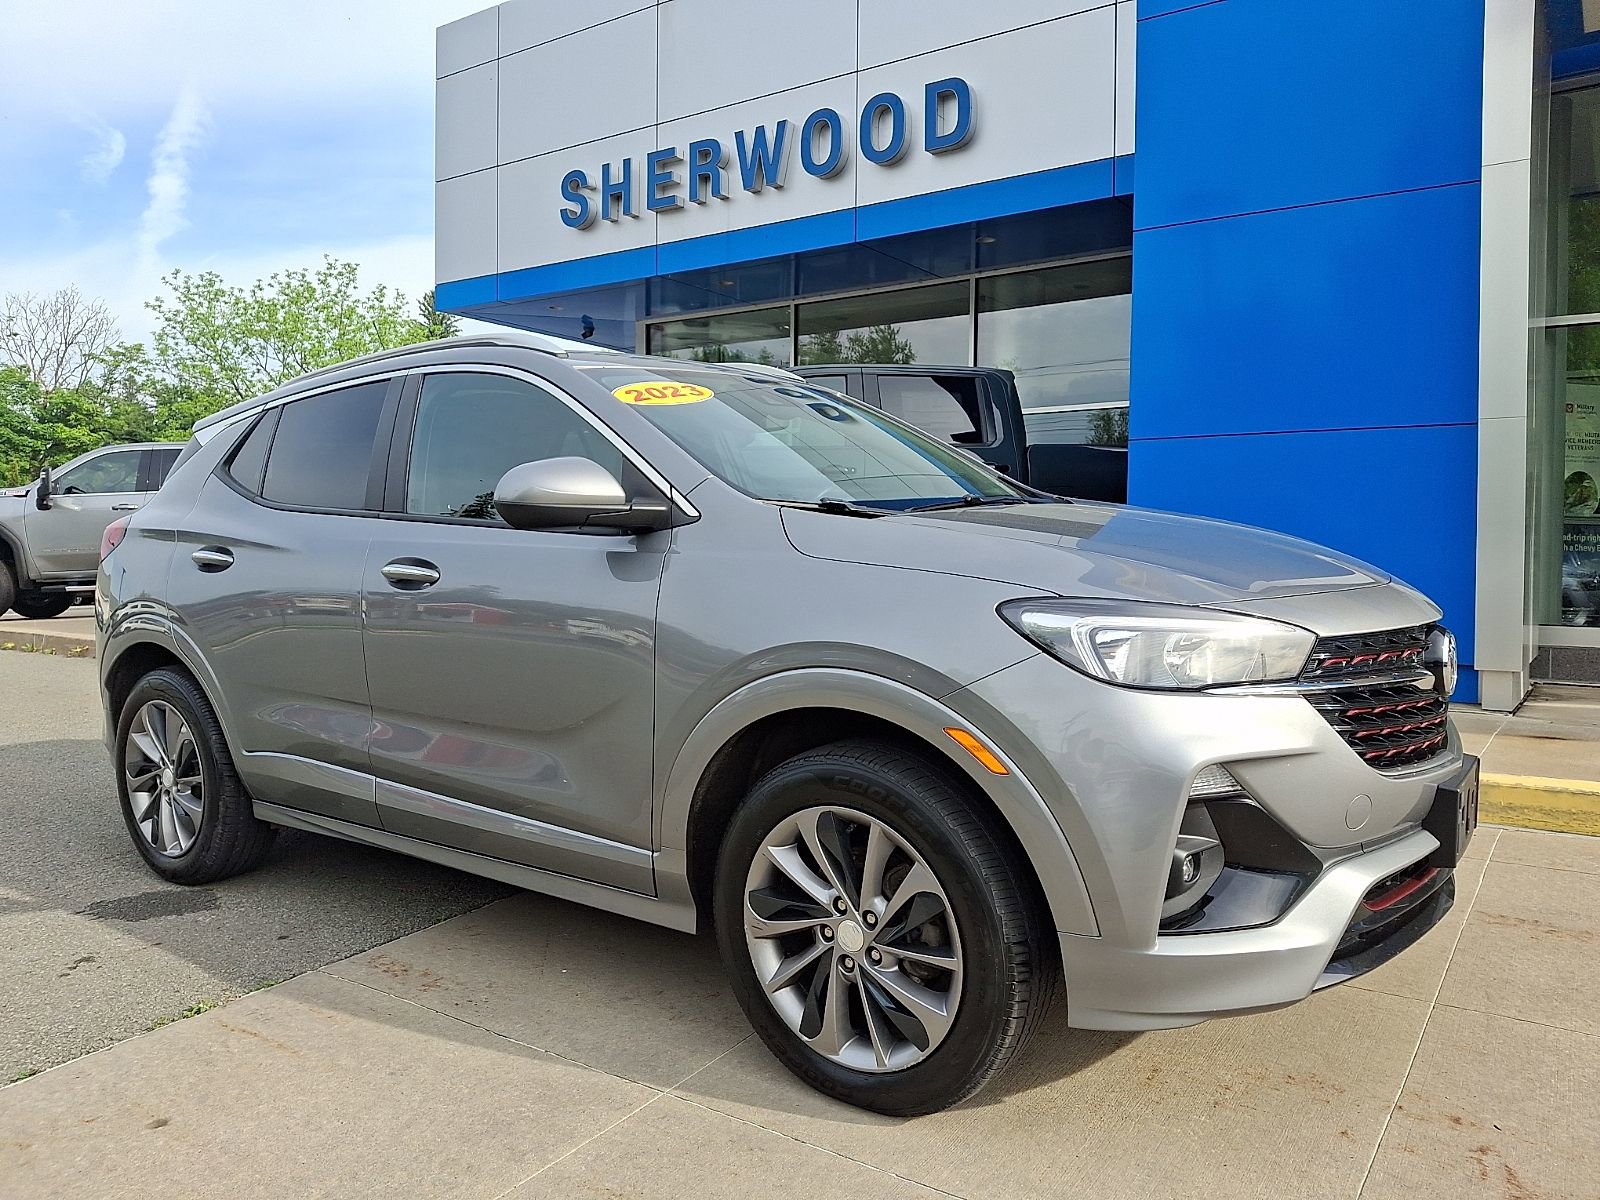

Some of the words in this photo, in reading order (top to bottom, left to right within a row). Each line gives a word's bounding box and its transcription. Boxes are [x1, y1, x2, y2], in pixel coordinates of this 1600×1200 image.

[559, 77, 975, 230] SHERWOOD
[625, 385, 704, 402] 2023
[1574, 544, 1595, 552] Chevy
